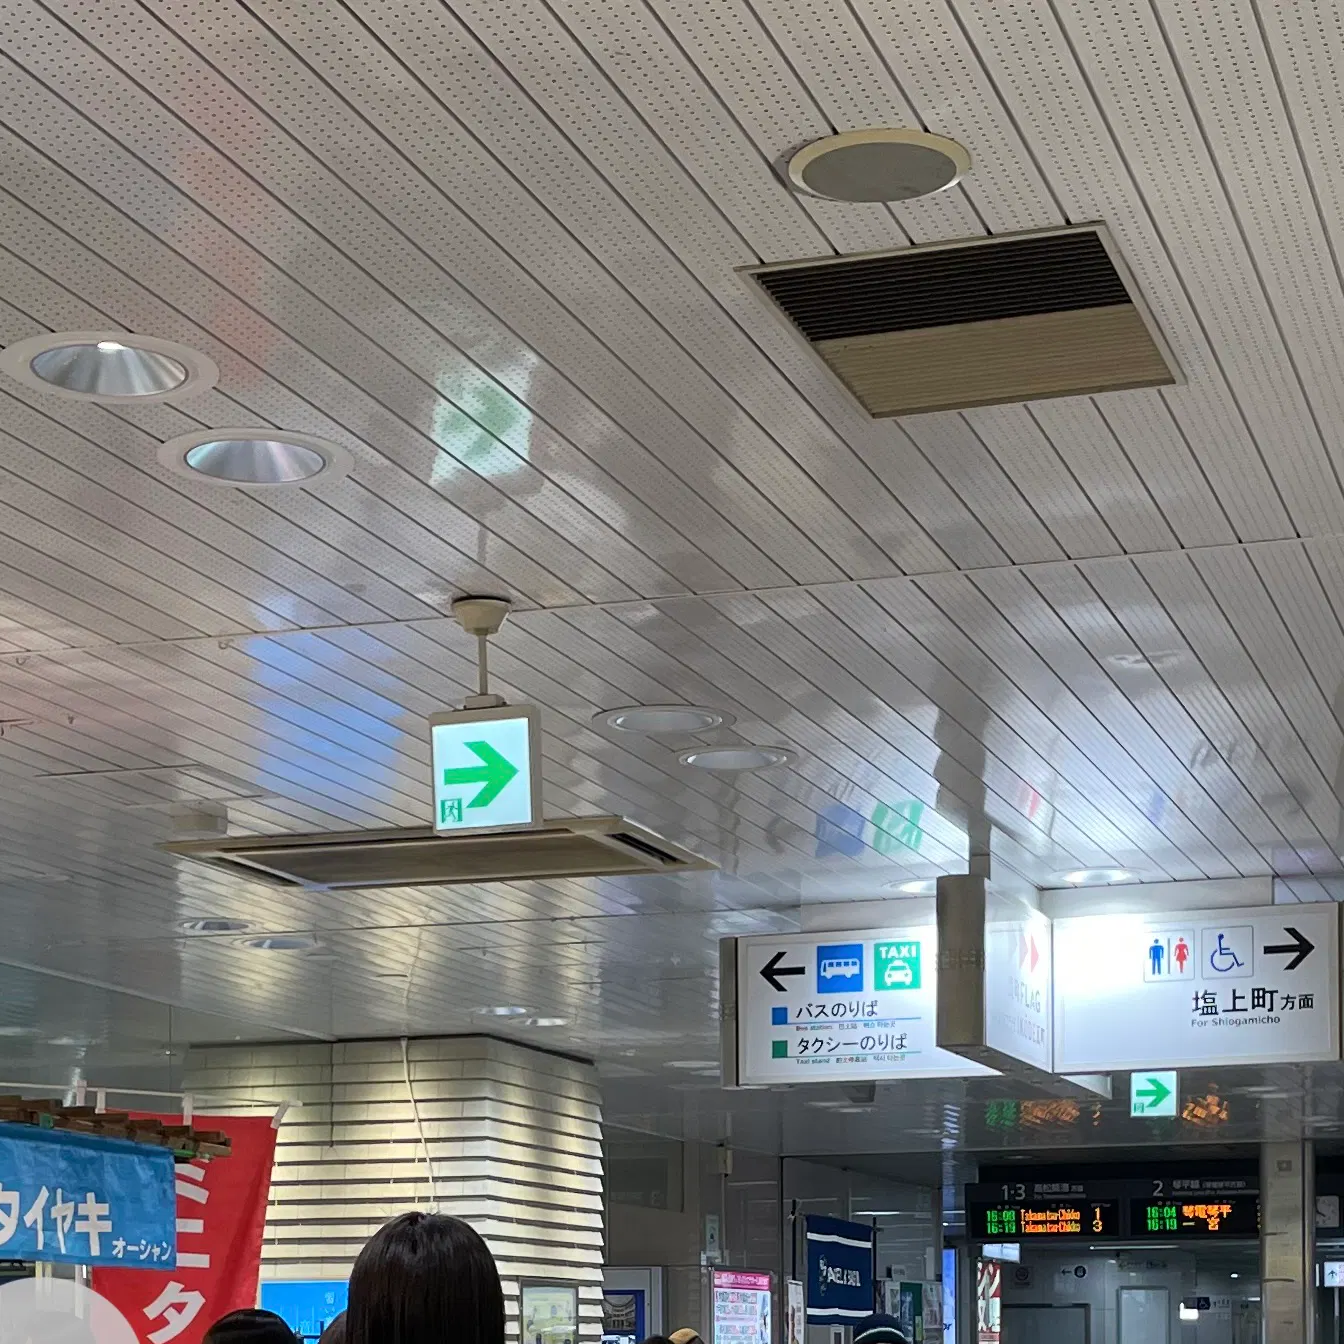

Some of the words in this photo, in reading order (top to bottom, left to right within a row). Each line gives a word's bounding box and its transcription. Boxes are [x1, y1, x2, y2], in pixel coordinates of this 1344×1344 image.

[879, 945, 917, 959] TAXI
[795, 1000, 878, 1019] バスのりば
[1192, 987, 1315, 1017] 塩上町方面
[1191, 1018, 1209, 1028] For
[1211, 1014, 1281, 1028] Shiogamicho
[796, 1032, 908, 1055] タクシーのりば
[1152, 1181, 1164, 1196] 2
[1095, 1207, 1101, 1220] 1
[1093, 1220, 1102, 1232] 3
[111, 1237, 172, 1261] オーシャン
